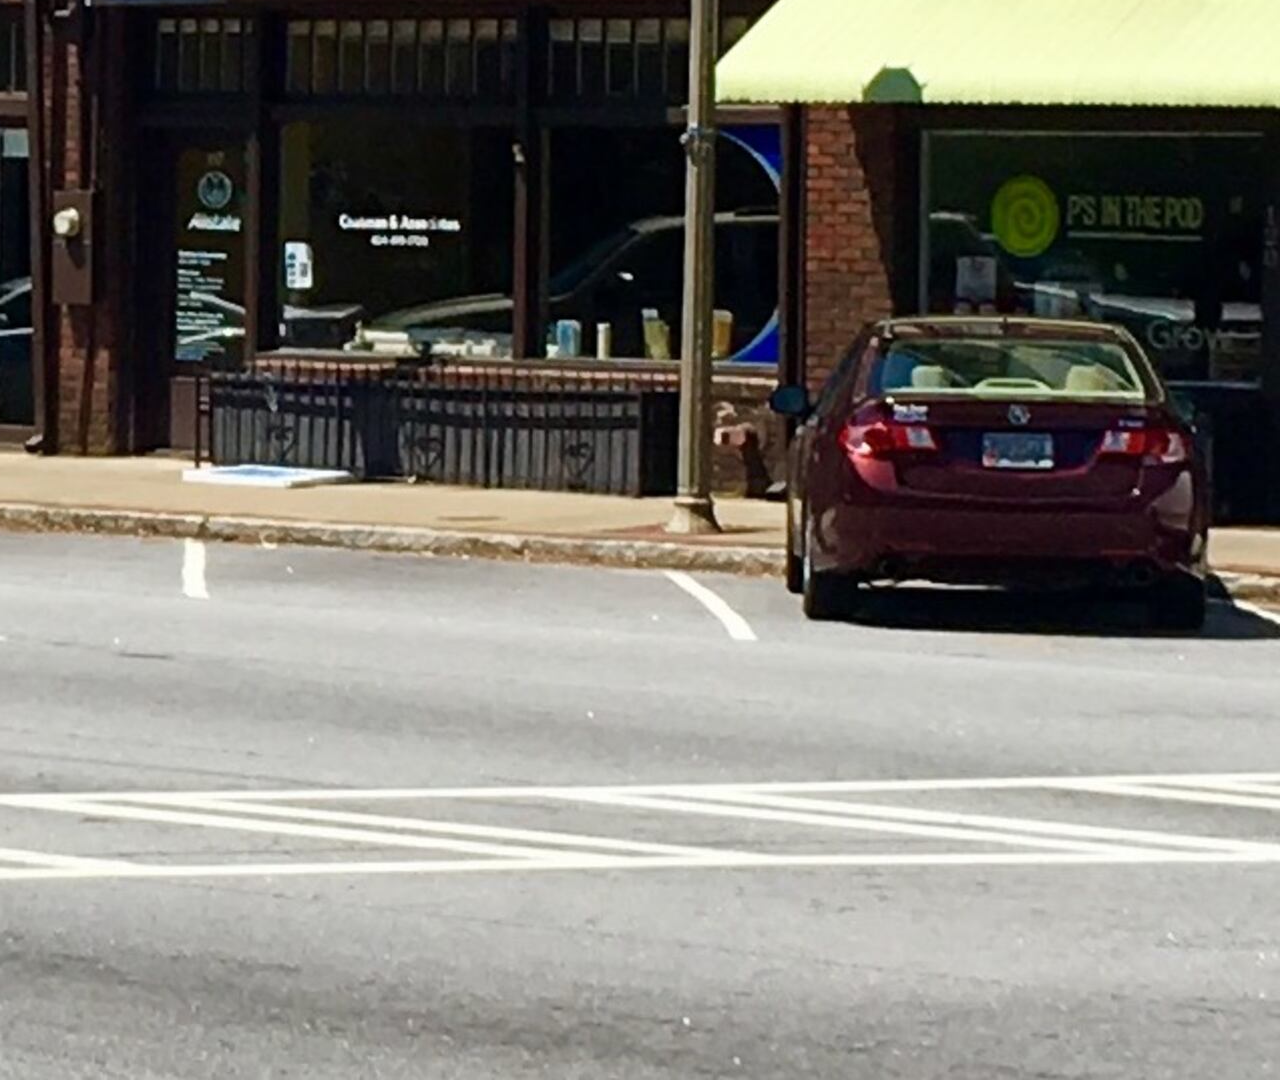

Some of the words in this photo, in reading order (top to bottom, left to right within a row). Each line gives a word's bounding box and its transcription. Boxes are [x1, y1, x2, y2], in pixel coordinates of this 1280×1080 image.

[1101, 196, 1121, 226] IN
[1123, 196, 1162, 228] THE
[1163, 196, 1203, 230] POD
